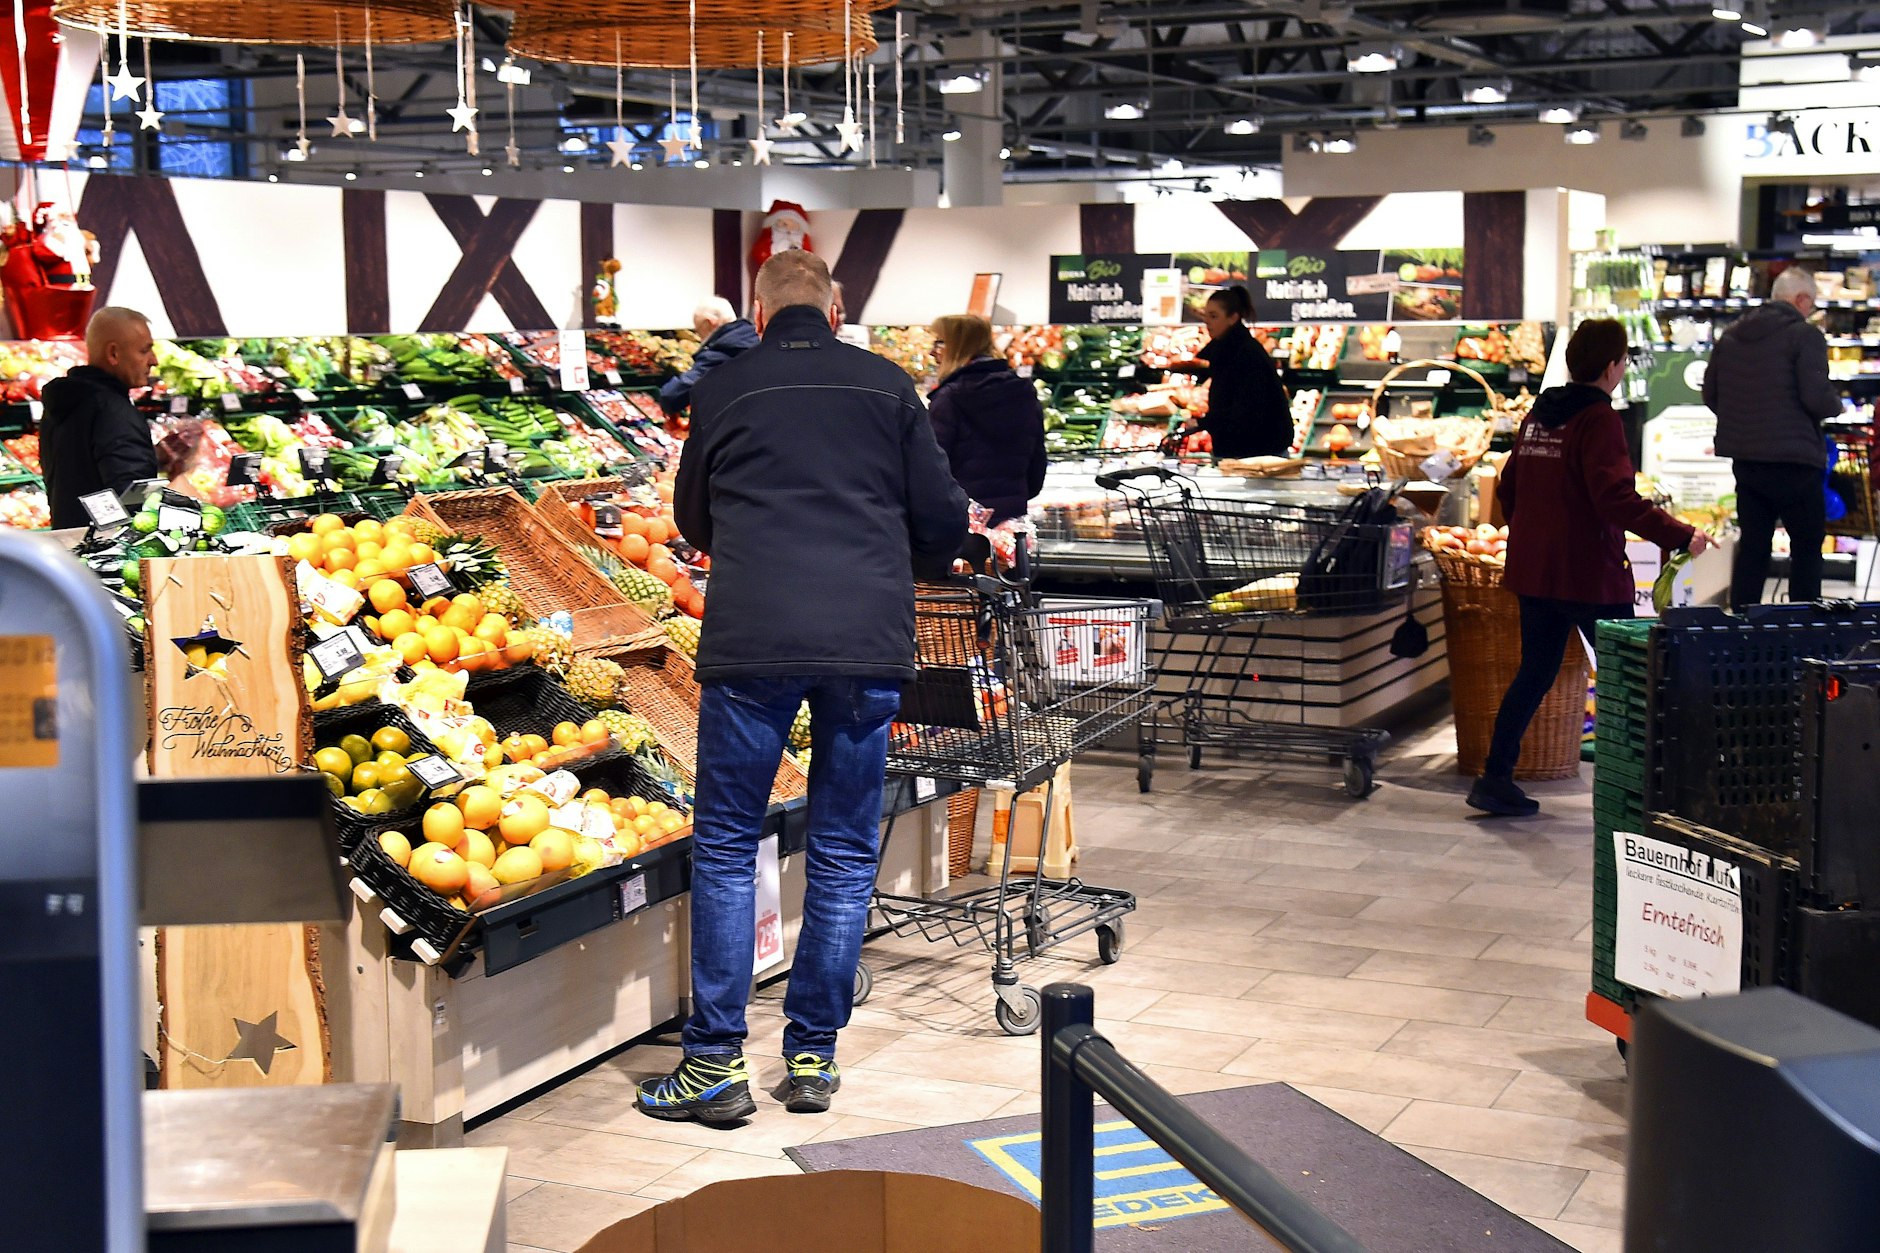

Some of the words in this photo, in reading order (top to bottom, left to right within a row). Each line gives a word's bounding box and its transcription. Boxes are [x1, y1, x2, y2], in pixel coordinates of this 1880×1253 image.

[1745, 114, 1880, 158] BÄCK
[1624, 838, 1701, 879] Bauernhof
[1642, 902, 1725, 949] Erntefrisch
[1093, 1188, 1222, 1218] EDEK
